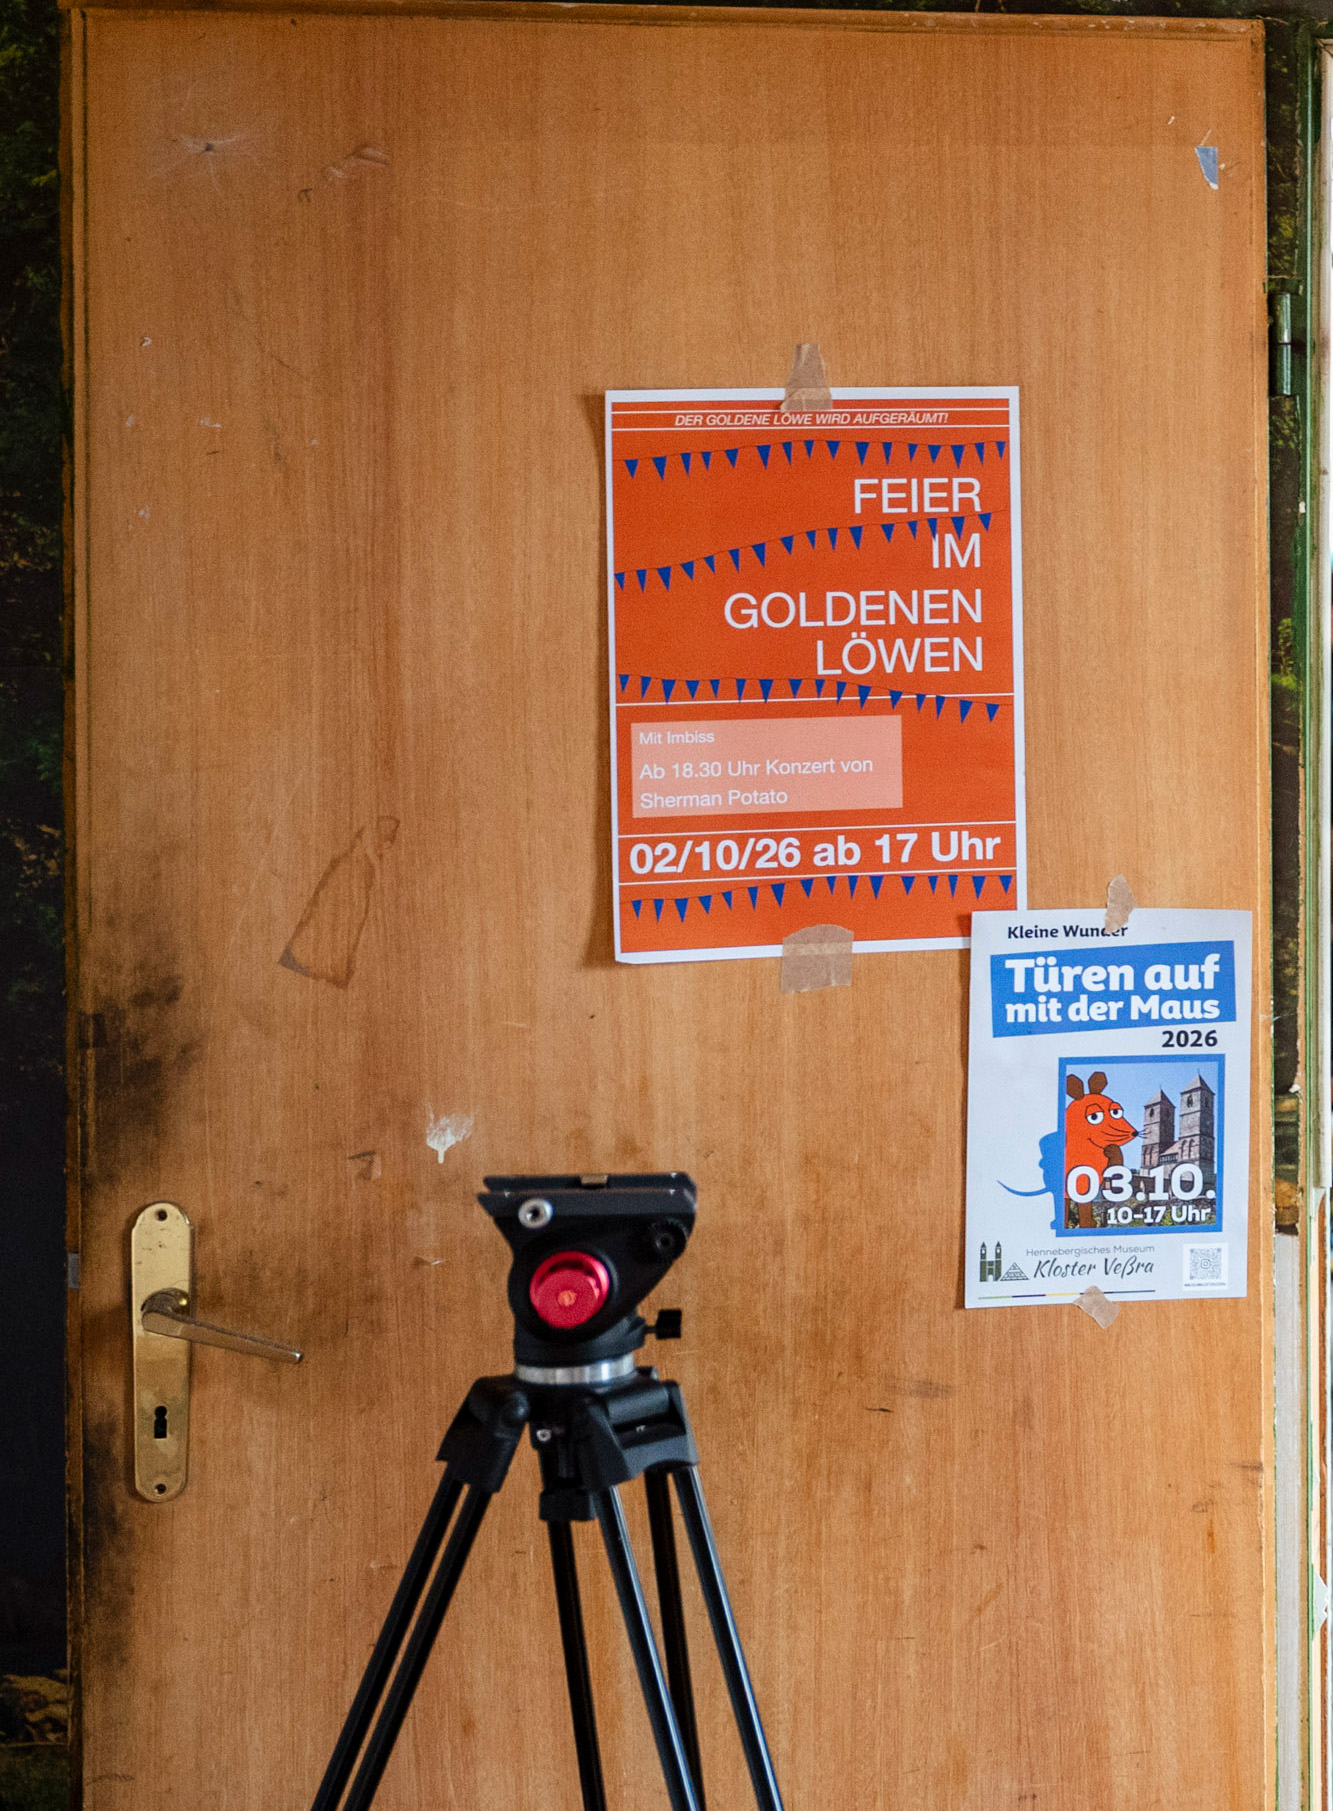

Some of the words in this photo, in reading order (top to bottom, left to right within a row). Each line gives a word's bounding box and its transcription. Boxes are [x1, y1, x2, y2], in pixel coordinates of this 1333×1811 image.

[675, 413, 703, 426] DER
[706, 413, 770, 426] GOLDENE
[773, 411, 813, 425] LÖWE
[816, 411, 851, 424] WIRD
[853, 410, 949, 423] AUFGERÄUMT!
[854, 477, 982, 514] FEIER
[932, 533, 981, 568] IM
[724, 588, 982, 629] GOLDENEN
[816, 631, 983, 675] LÖWEN
[639, 732, 663, 745] Mit
[667, 730, 715, 744] Imbiss
[640, 764, 665, 780] Ab
[672, 762, 722, 778] 18.30
[728, 760, 760, 776] Uhr
[766, 758, 836, 776] Konzert
[840, 759, 873, 773] von
[640, 792, 722, 808] Sherman
[728, 789, 788, 806] Potato
[629, 837, 801, 875] 02/10/26
[813, 841, 861, 867] ab
[875, 833, 918, 864] 17
[931, 830, 1001, 863] Uhr
[1008, 925, 1059, 939] Kleine
[1005, 957, 1135, 993] Türen
[1144, 953, 1221, 991] auf
[1005, 995, 1062, 1023] mit
[1067, 993, 1124, 1022] der
[1130, 994, 1221, 1021] Maus
[1161, 1029, 1218, 1048] 2026
[1066, 1162, 1216, 1204] 03.10.
[1171, 1205, 1211, 1223] Uhr
[1026, 1247, 1111, 1258] Hennebergisches
[1113, 1245, 1155, 1254] Museum
[1033, 1257, 1096, 1279] Kloster
[1104, 1254, 1155, 1279] Veßra
